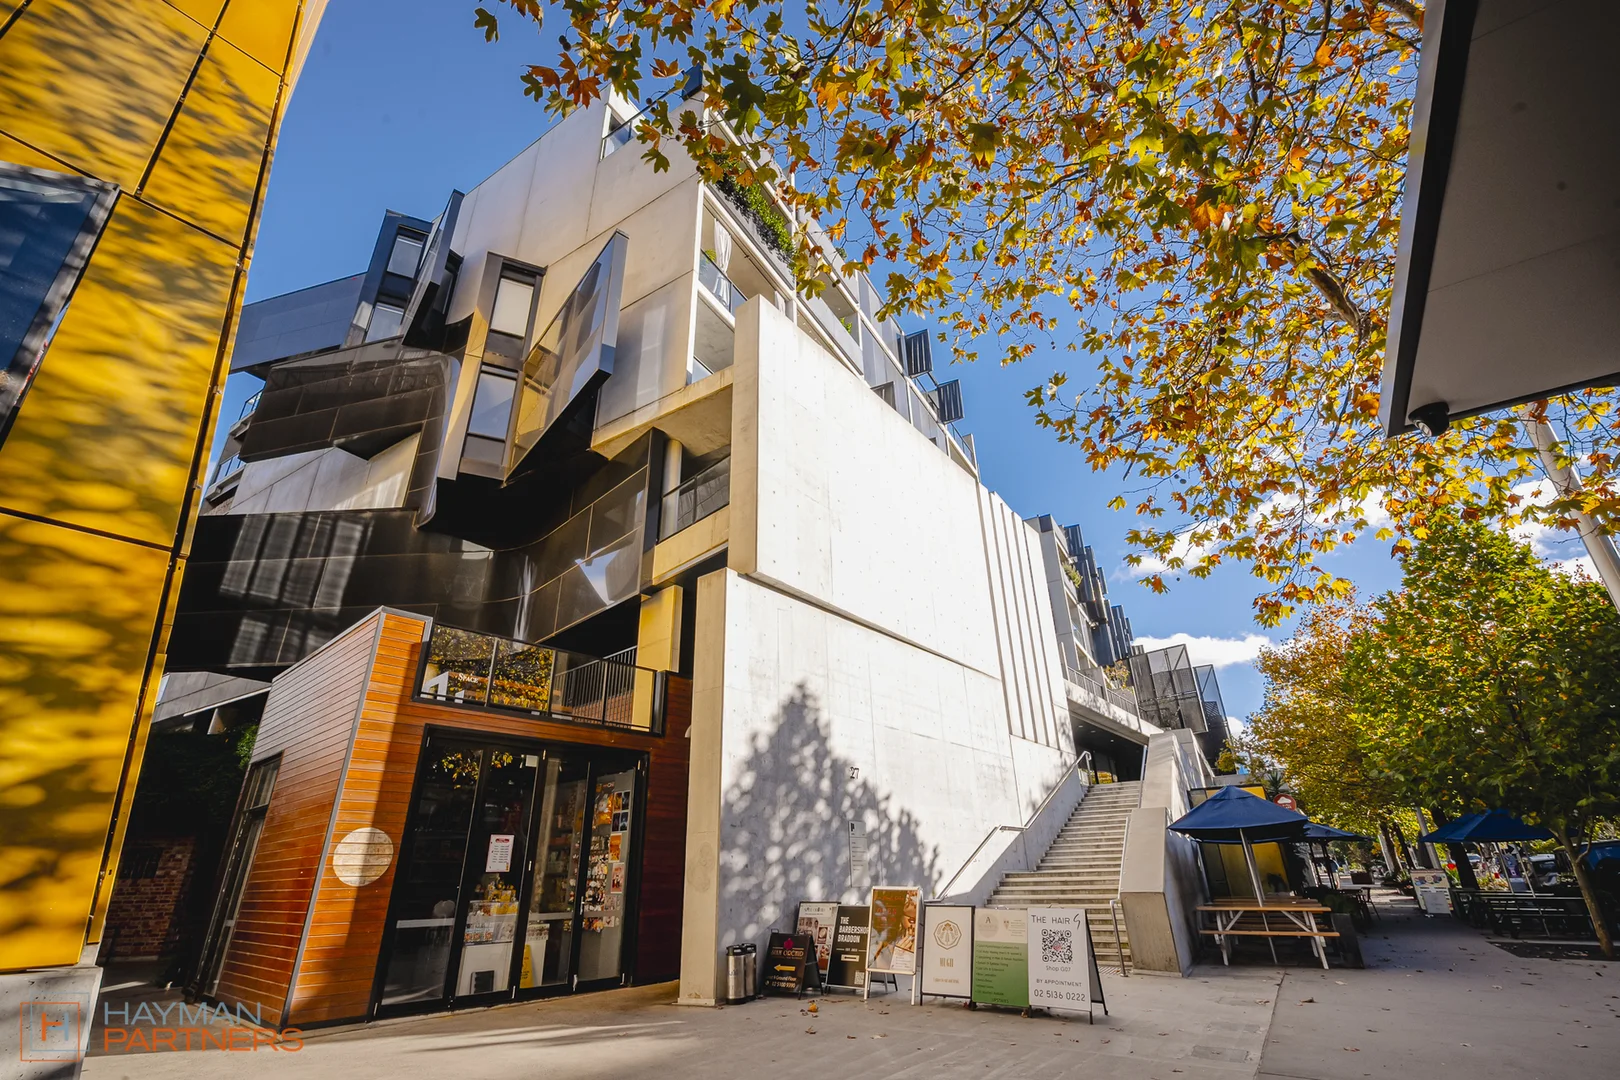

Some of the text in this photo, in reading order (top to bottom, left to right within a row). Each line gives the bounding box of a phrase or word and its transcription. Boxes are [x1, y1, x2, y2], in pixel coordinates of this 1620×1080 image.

[1031, 915, 1046, 923] THE
[838, 935, 860, 943] BRADDON
[1034, 989, 1085, 1002] 02 5136 0222
